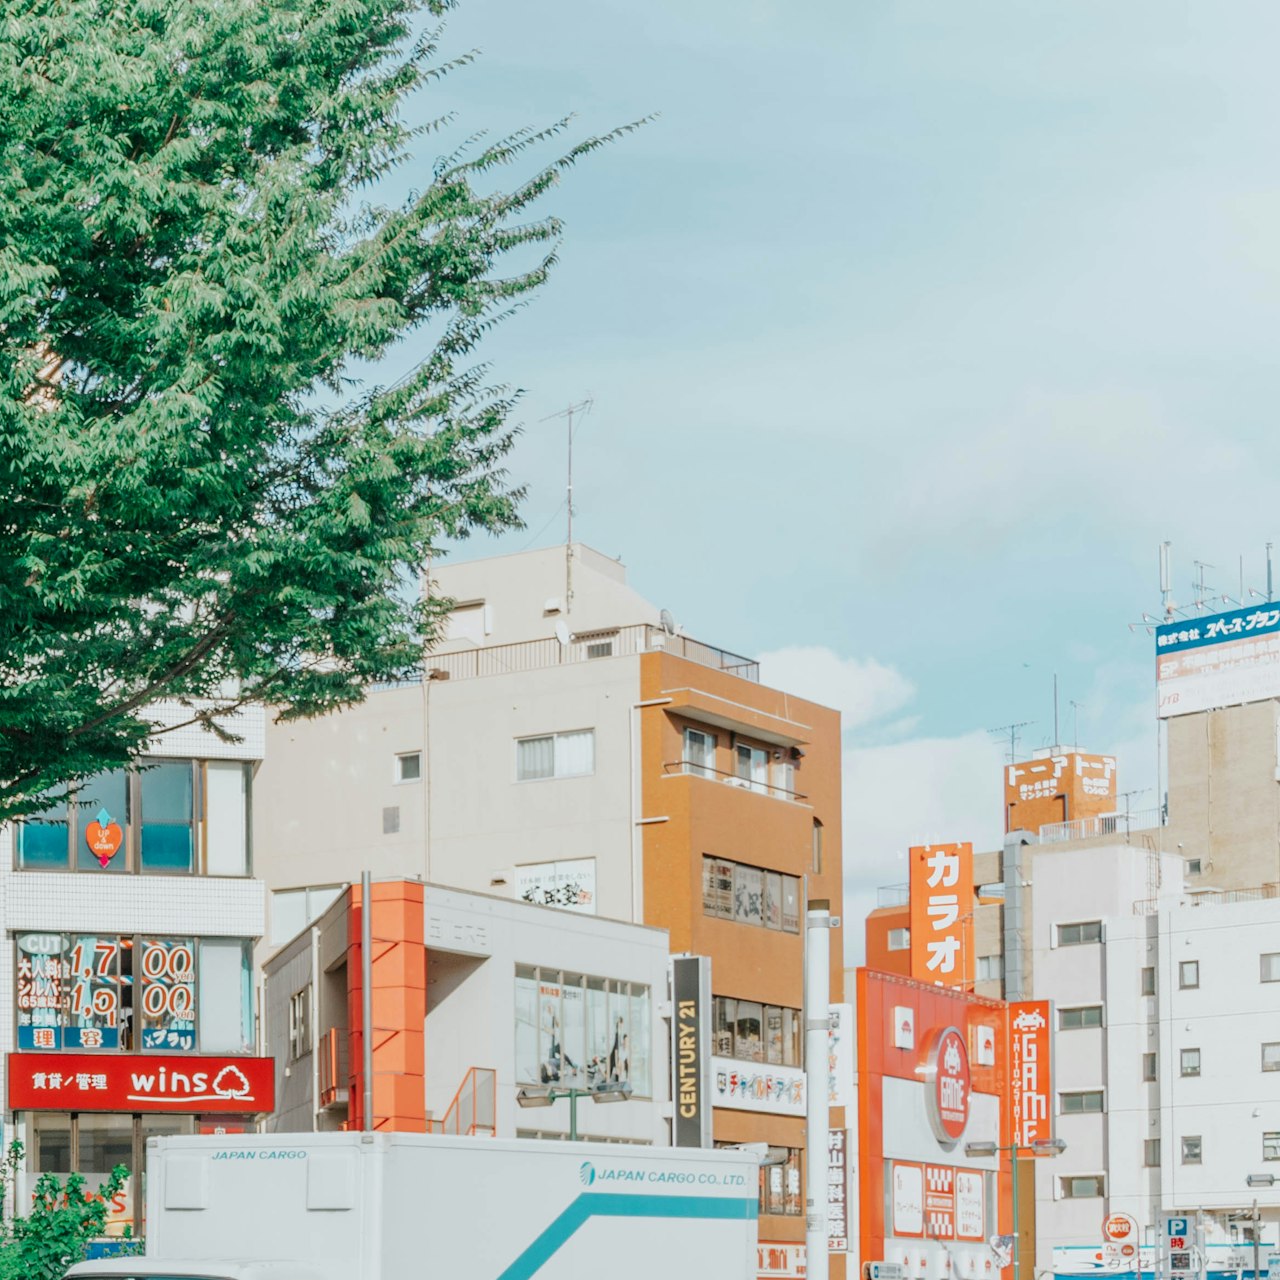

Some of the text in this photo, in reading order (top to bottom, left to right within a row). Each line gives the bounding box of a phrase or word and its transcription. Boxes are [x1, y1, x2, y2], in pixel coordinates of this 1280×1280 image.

[1009, 756, 1068, 787] トーア
[1076, 756, 1116, 779] トーア
[1020, 788, 1057, 801] マンション
[926, 851, 960, 991] カラオ
[26, 937, 60, 951] CUT
[18, 959, 70, 979] 大人料金
[680, 1001, 697, 1118] CENTURY 21
[132, 1067, 208, 1093] wins
[1022, 1034, 1046, 1147] GAME
[940, 1076, 965, 1111] GAME
[211, 1150, 307, 1160] JAPAN CARGO
[598, 1169, 645, 1182] JAPAN
[648, 1172, 695, 1184] CARGO
[723, 1175, 746, 1186] LTD.
